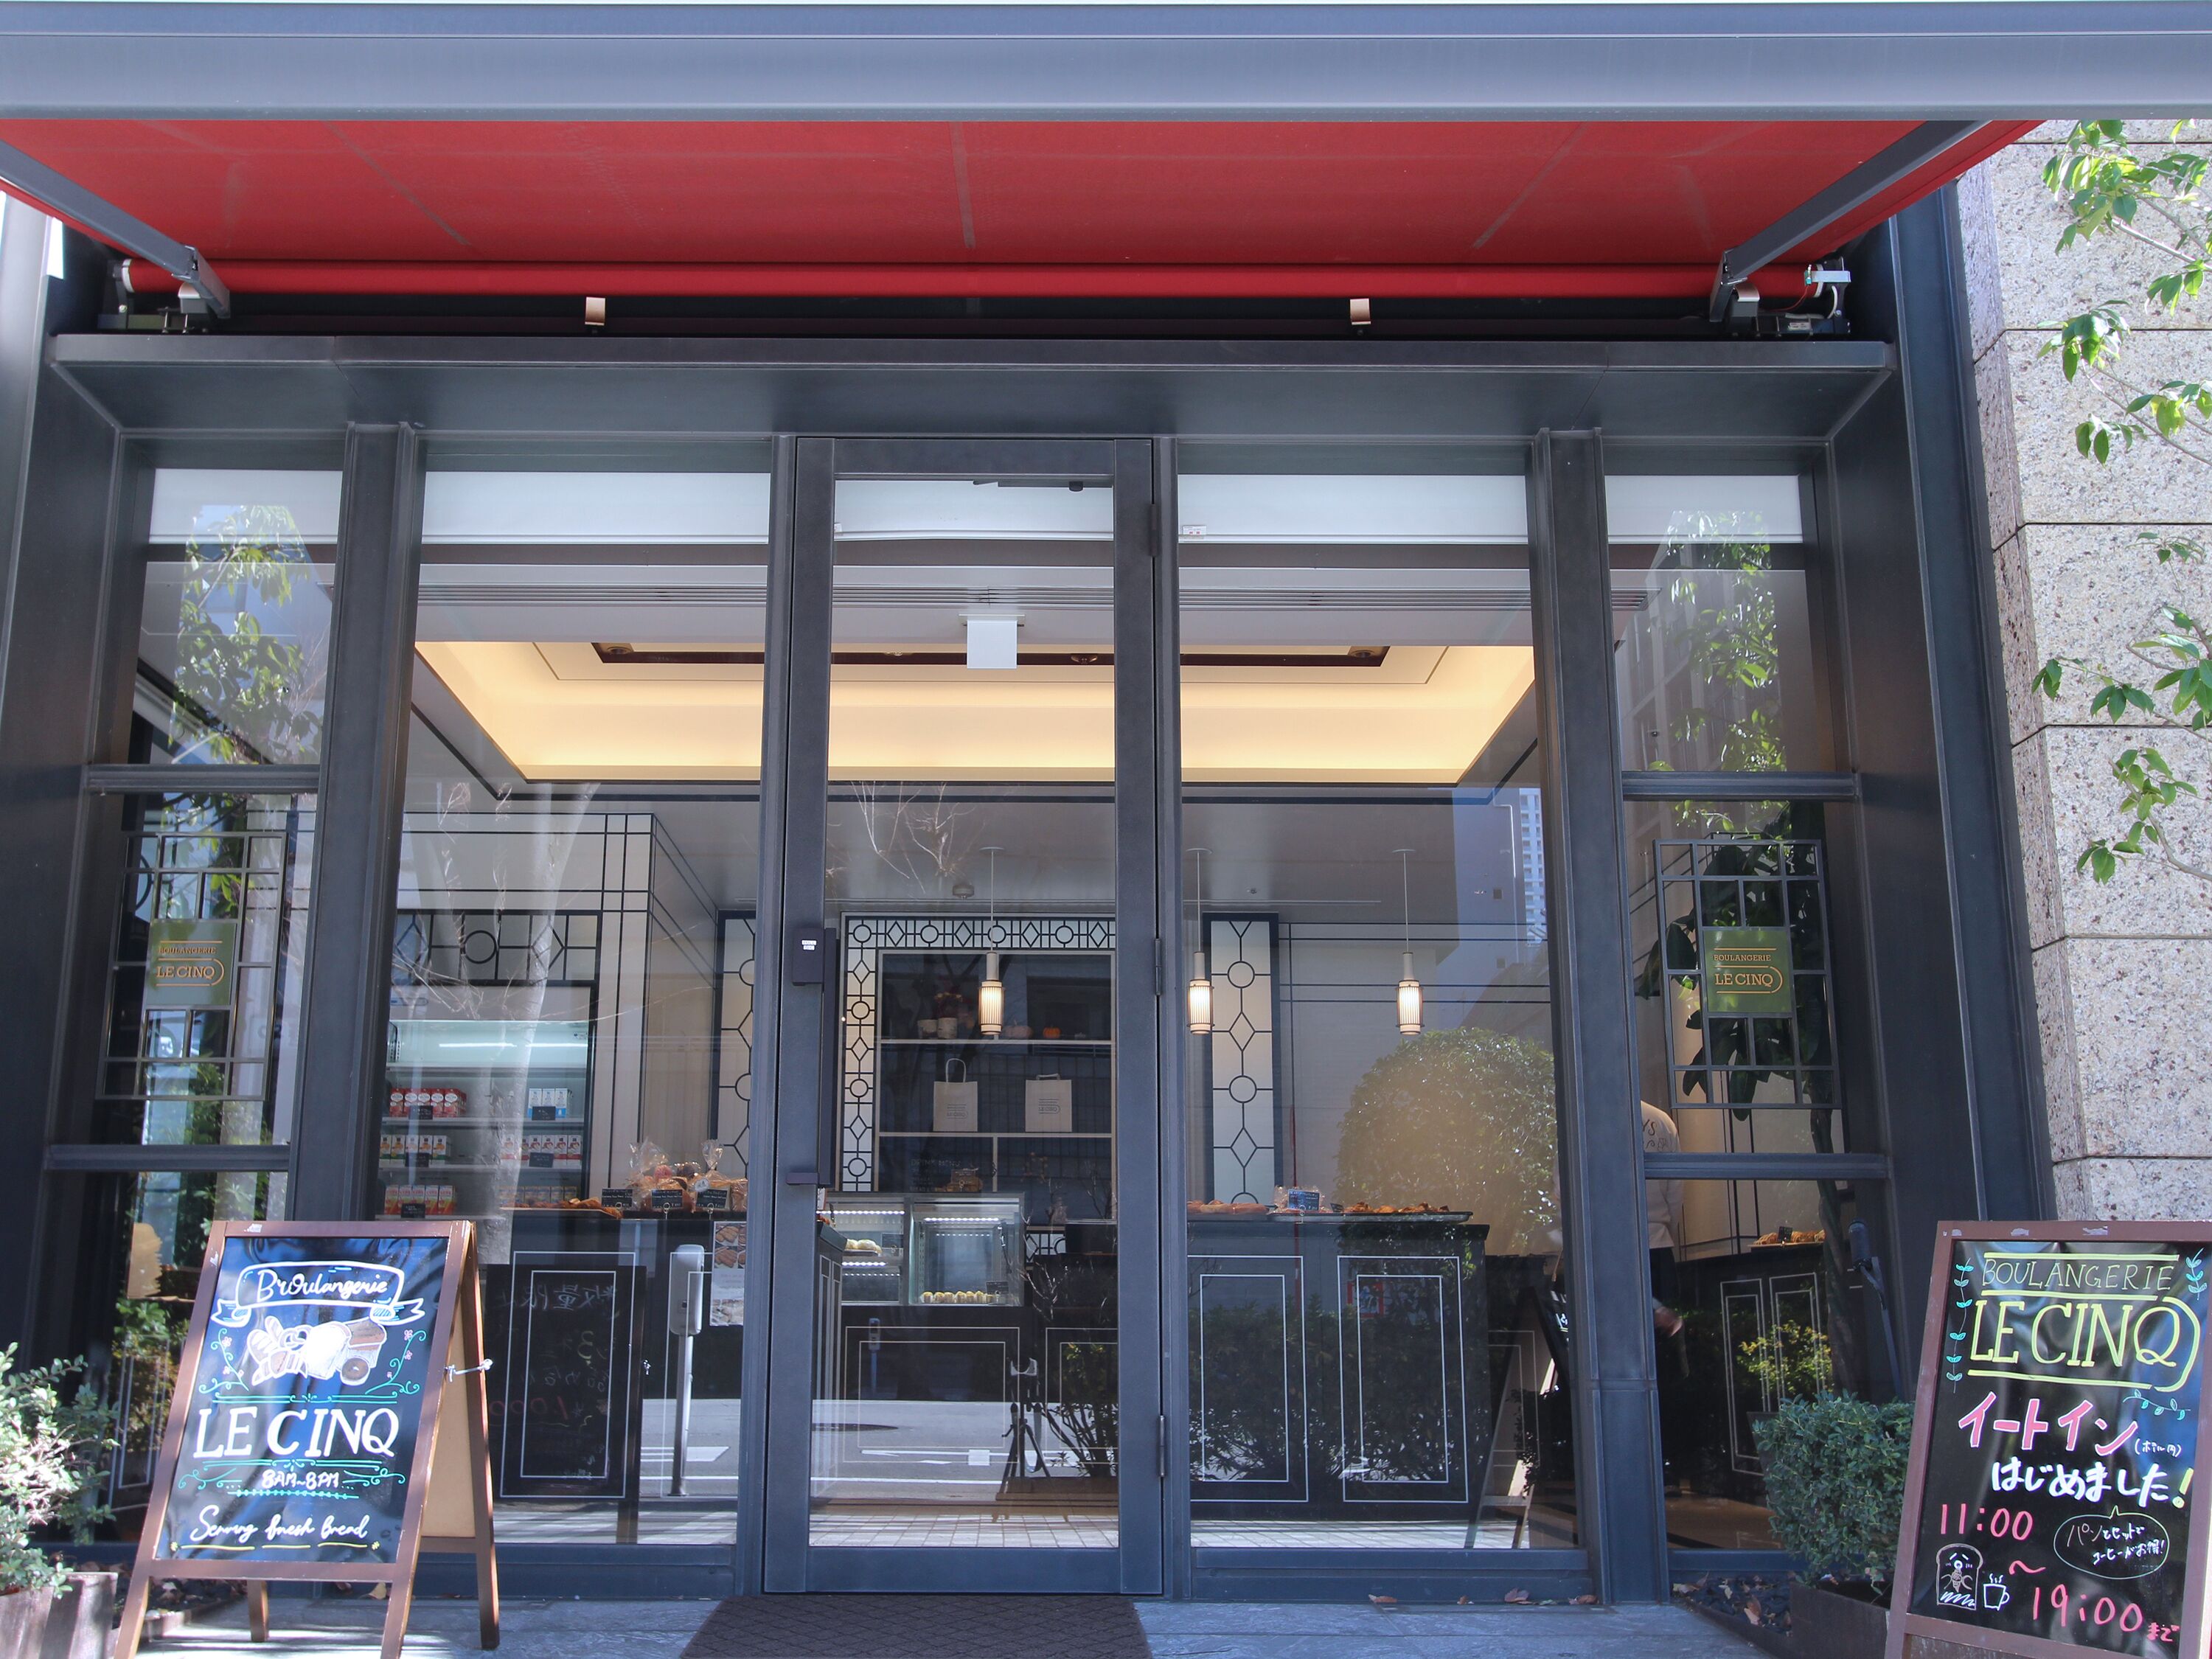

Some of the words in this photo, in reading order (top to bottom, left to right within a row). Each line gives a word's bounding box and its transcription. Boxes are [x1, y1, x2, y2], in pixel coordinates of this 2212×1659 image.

[156, 966, 175, 978] LE
[176, 966, 215, 980] CINQ
[1714, 973, 1733, 985] LE
[1735, 973, 1773, 987] CINQ
[1981, 1259, 2175, 1292] BOULANGERIE
[1970, 1300, 2025, 1364] LE
[2031, 1302, 2180, 1368] CINQ
[193, 1406, 258, 1459] LE
[266, 1408, 399, 1458] CINQ
[1958, 1391, 2138, 1456] イートイン
[189, 1504, 258, 1543] Serving
[265, 1514, 315, 1540] fresh
[1940, 1503, 2034, 1541] 11:00
[2067, 1523, 2145, 1547] パンとセットで
